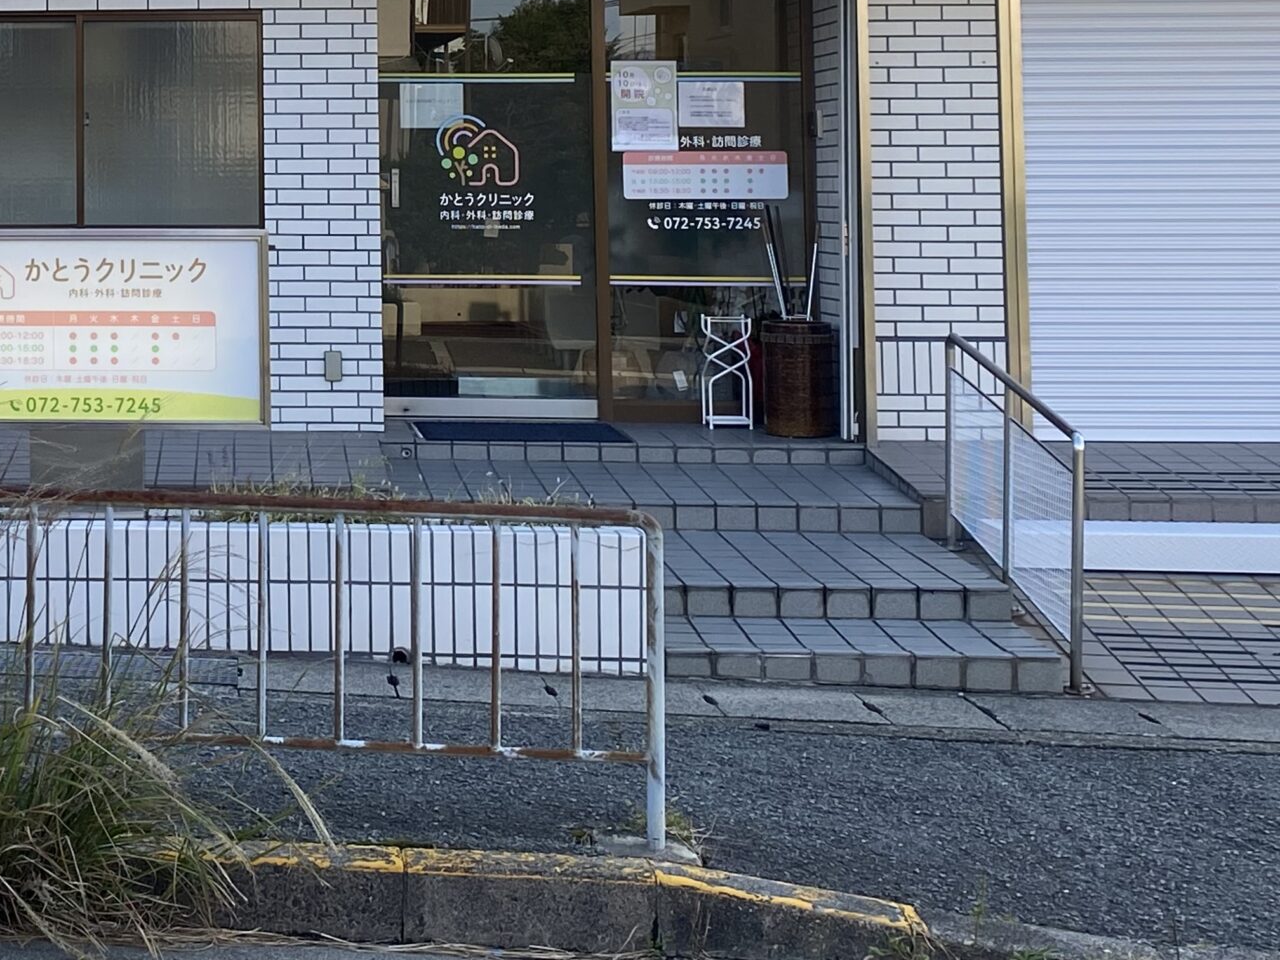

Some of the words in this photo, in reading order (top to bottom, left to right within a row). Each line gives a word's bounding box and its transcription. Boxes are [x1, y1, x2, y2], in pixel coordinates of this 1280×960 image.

[439, 192, 535, 206] かとうクリニック
[439, 209, 535, 220] 内科・外科・訪問診療
[663, 217, 761, 229] 072-753-7245
[24, 257, 207, 283] かとうクリニック
[26, 397, 161, 413] 072-753-7245
